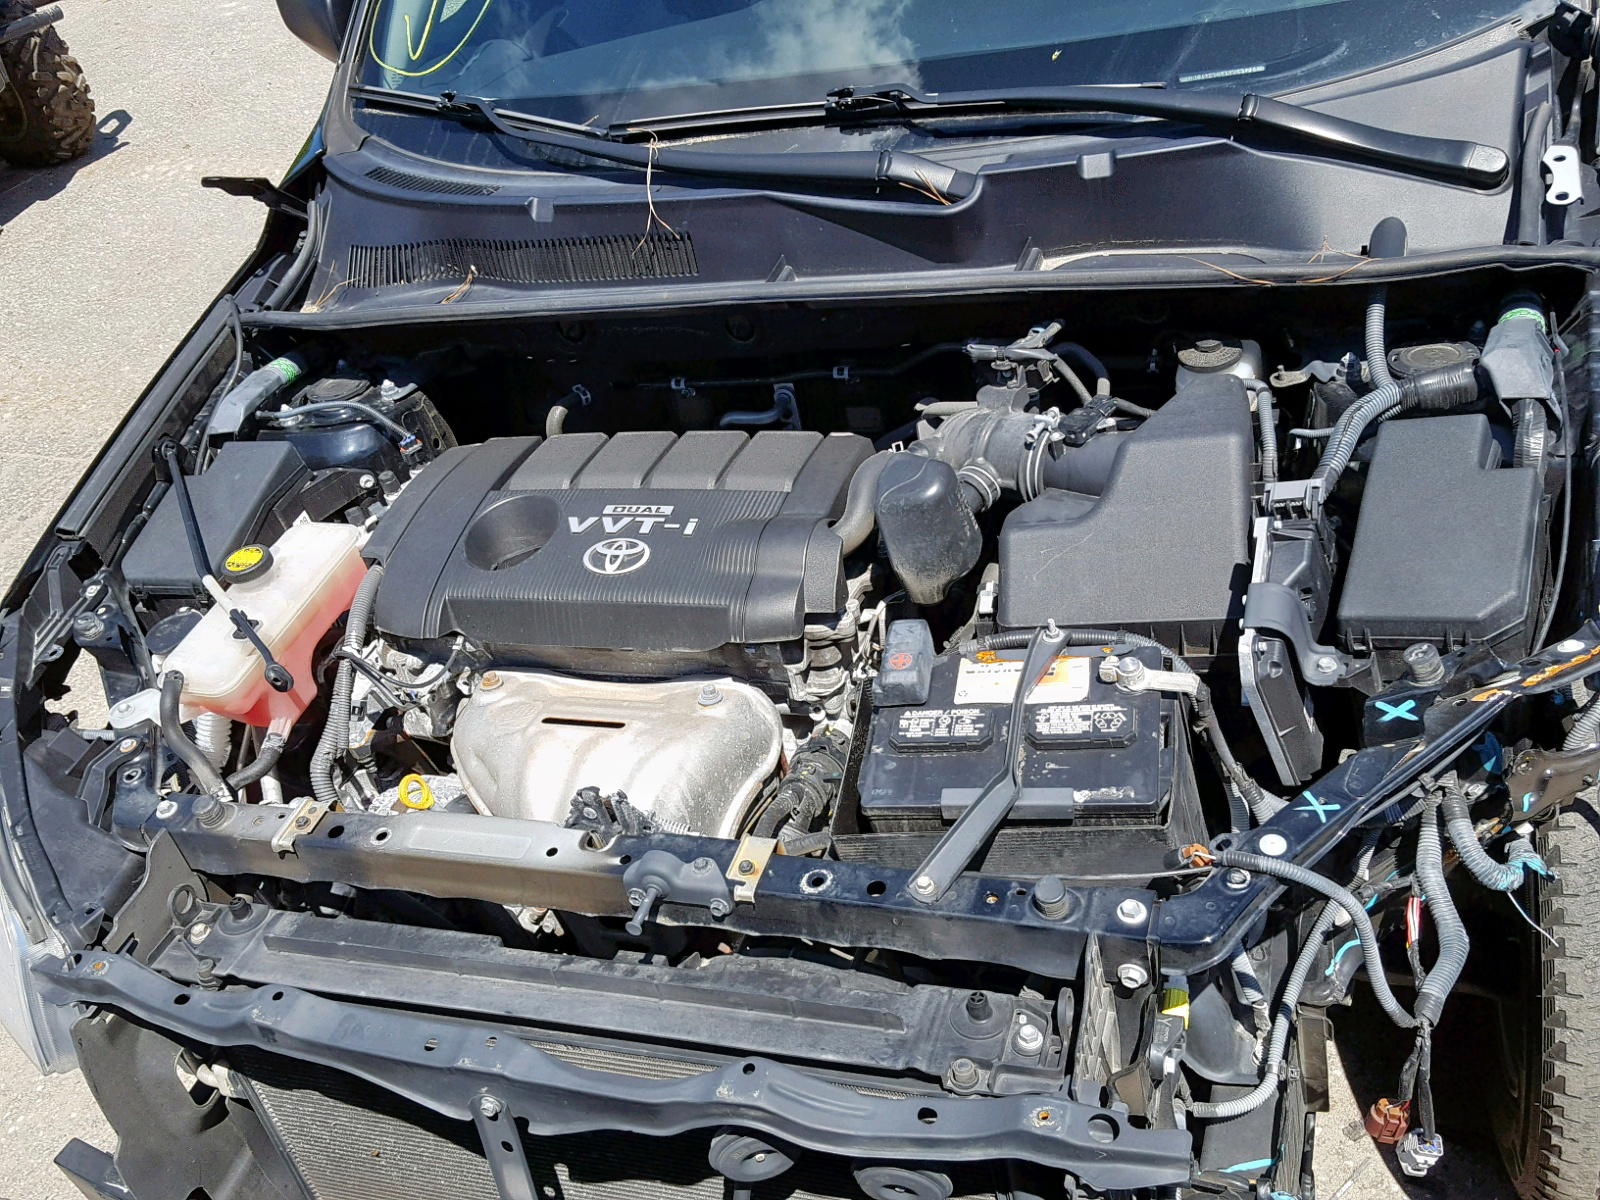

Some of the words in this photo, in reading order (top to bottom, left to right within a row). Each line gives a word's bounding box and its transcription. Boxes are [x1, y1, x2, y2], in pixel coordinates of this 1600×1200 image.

[612, 505, 666, 514] DUAL
[567, 516, 699, 536] VVT-i
[911, 709, 944, 717] DANGER
[950, 708, 981, 716] POISON
